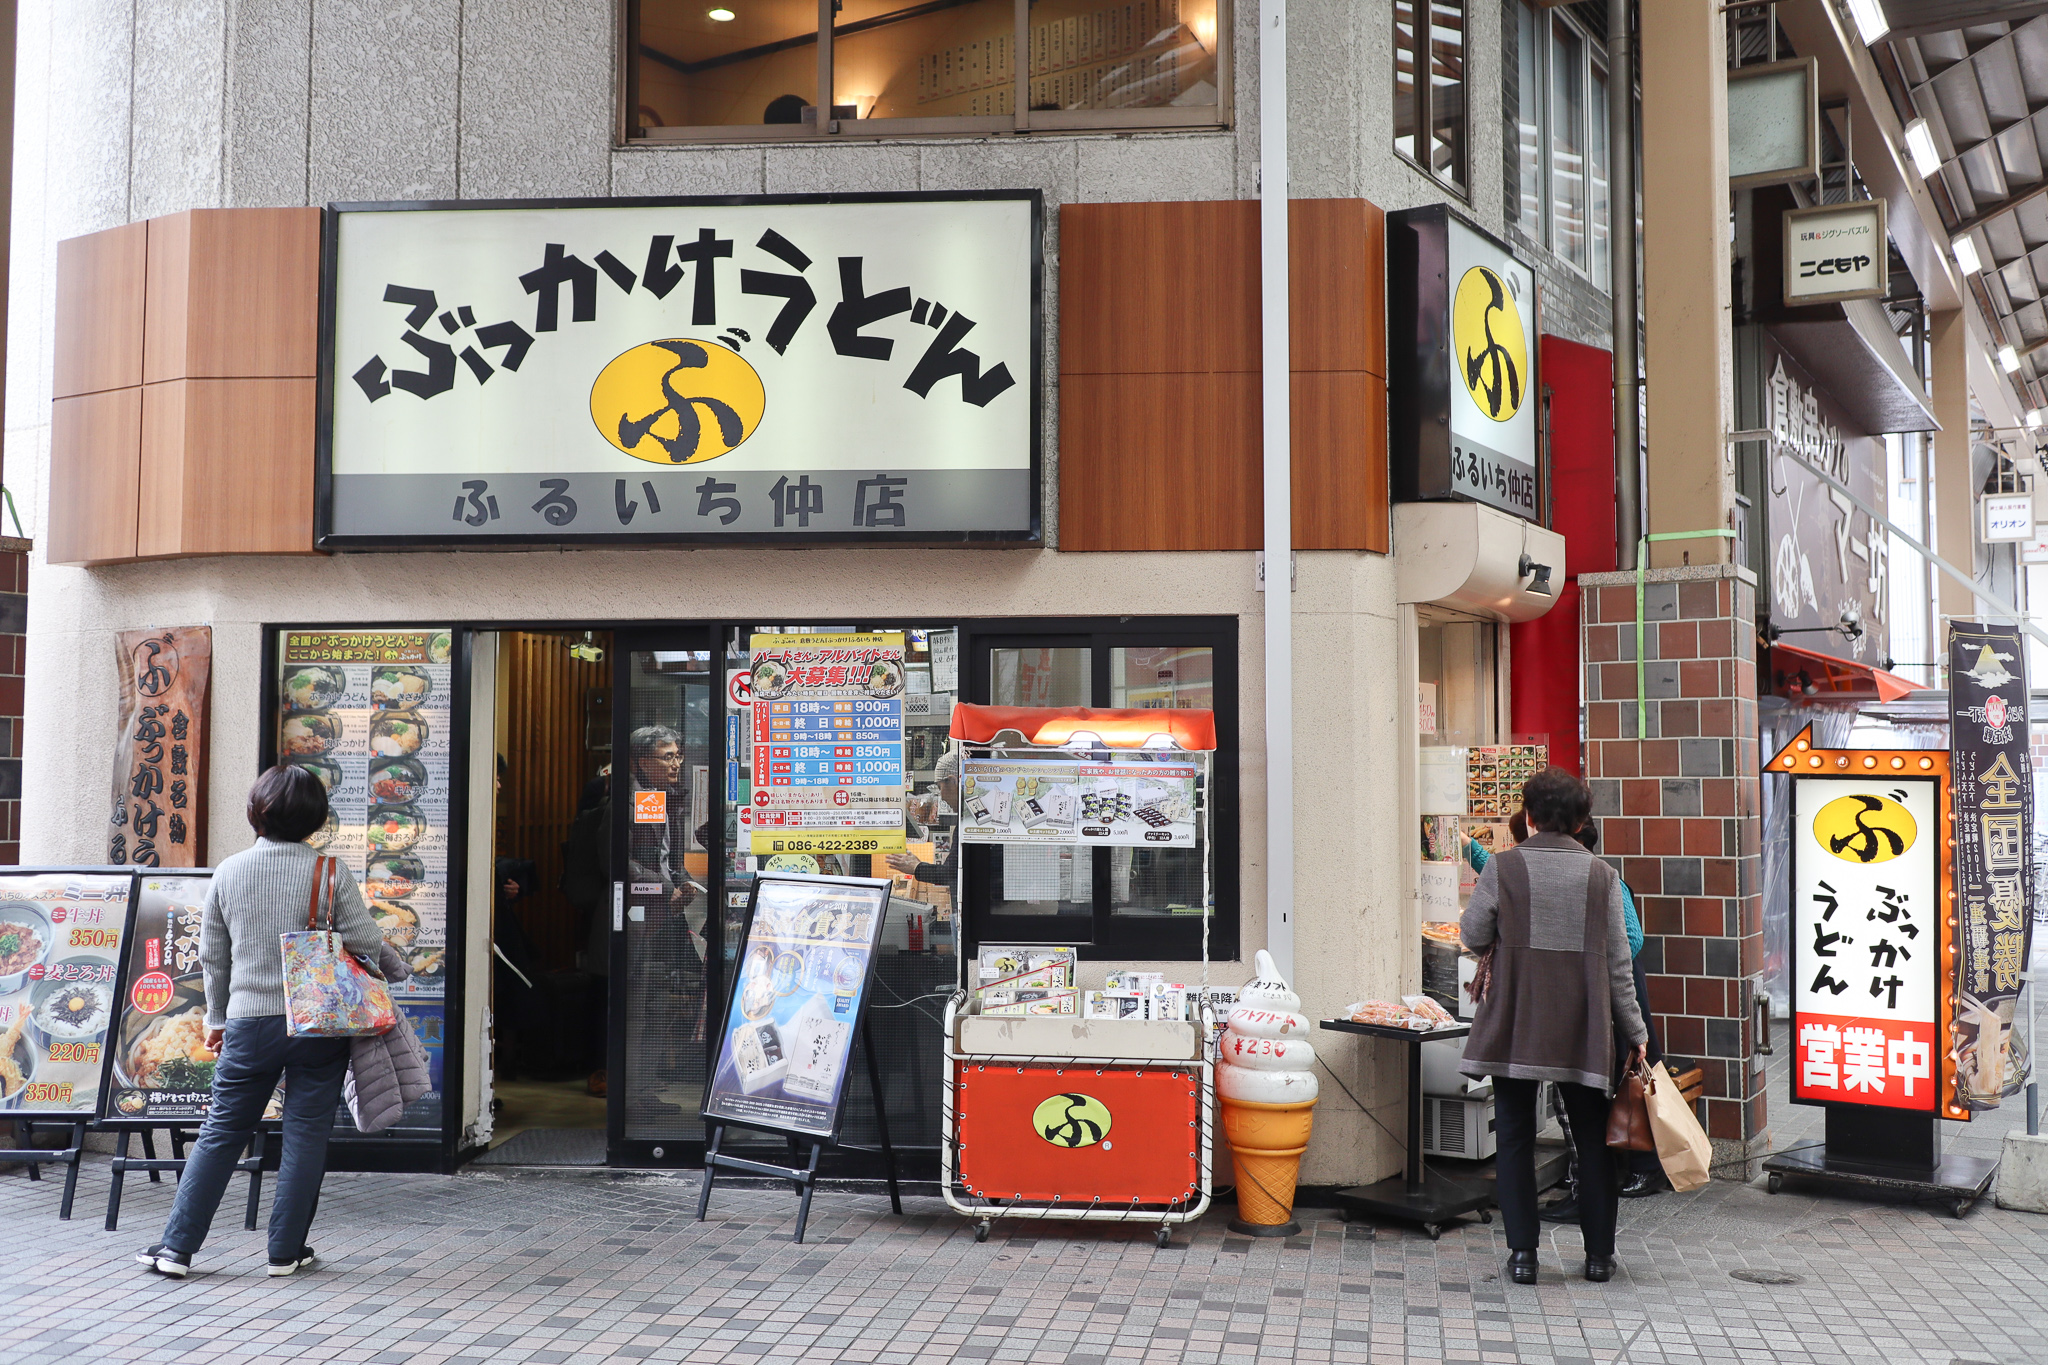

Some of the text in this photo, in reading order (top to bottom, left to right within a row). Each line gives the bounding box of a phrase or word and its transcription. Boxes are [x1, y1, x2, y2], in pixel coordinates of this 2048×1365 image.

[1800, 255, 1870, 278] こどもや
[352, 227, 1016, 408] ぶっかけうどん
[1453, 446, 1534, 510] ふるいち仲店
[452, 474, 907, 528] ふるいち仲店
[1991, 520, 2026, 529] オリオン
[753, 648, 902, 664] パートさん・アルバイトさん
[784, 665, 874, 688] 大募集!!!
[309, 692, 367, 702] ぶっかけうどん
[835, 703, 852, 711] 時給
[855, 701, 890, 712] 900円
[835, 718, 852, 727] 時給
[855, 717, 899, 729] 1,000円
[324, 738, 366, 748] 肉ぶっかけ
[856, 732, 879, 740] 850円
[836, 747, 852, 756] 時給
[856, 746, 890, 757] 850円
[836, 763, 852, 771] 時給
[855, 761, 900, 773] 1,000円
[839, 776, 852, 784] 時給
[856, 776, 880, 784] 850円
[637, 803, 664, 812] 食べログ
[787, 840, 878, 851] 086-422-2389
[68, 907, 104, 924] 牛丼
[69, 929, 119, 948] 350円
[1810, 879, 1854, 996] うどん
[1868, 884, 1921, 1009] ぶっかけ
[44, 964, 116, 982] 麦とろ丼
[49, 1043, 100, 1063] 220円
[1234, 1038, 1287, 1058] ¥230
[1799, 1021, 1931, 1096] 営業中
[25, 1083, 73, 1103] 350円
